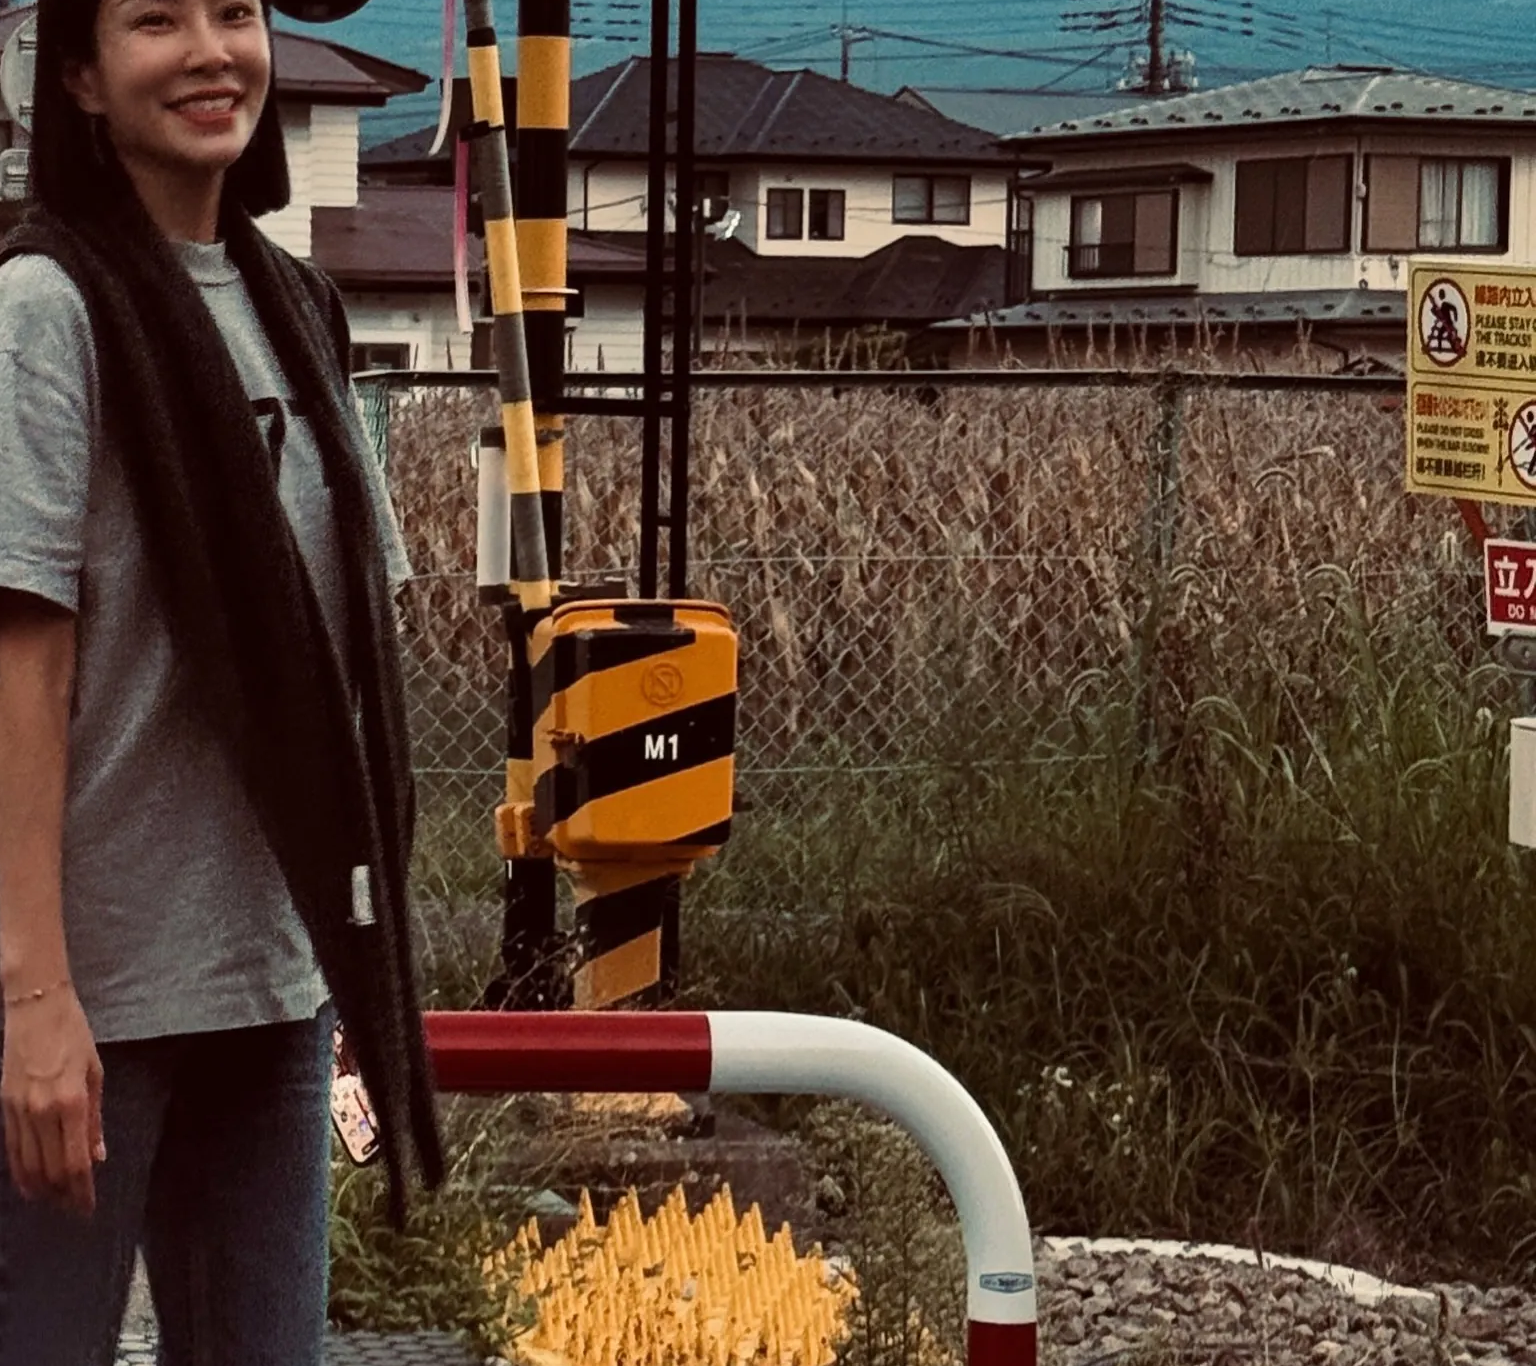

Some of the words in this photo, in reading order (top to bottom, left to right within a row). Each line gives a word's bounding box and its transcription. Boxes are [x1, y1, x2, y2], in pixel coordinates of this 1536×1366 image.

[1475, 314, 1507, 330] PLEASE
[1509, 316, 1531, 332] STAY
[1475, 330, 1492, 345] THE
[644, 734, 680, 761] M1
